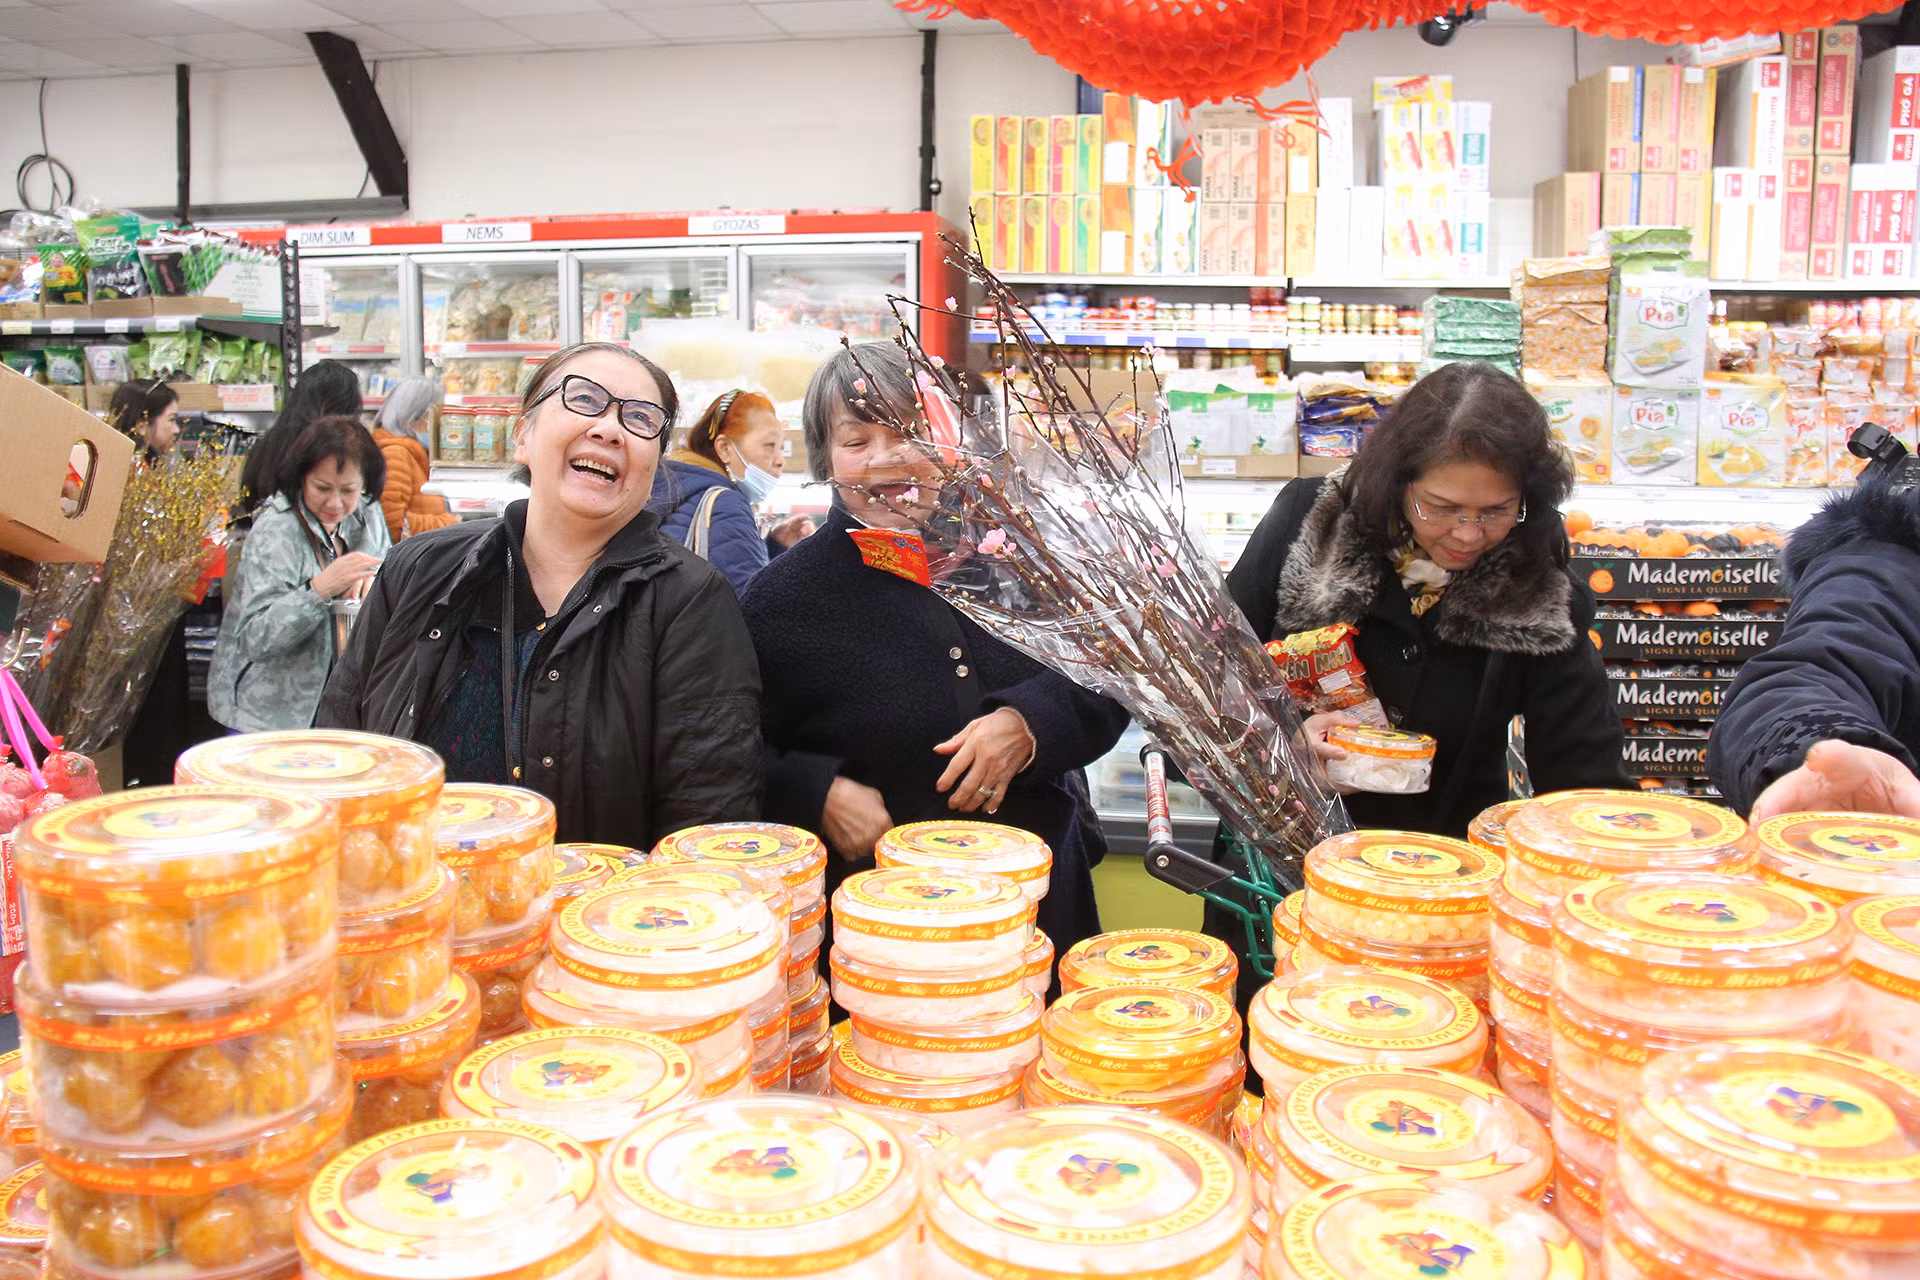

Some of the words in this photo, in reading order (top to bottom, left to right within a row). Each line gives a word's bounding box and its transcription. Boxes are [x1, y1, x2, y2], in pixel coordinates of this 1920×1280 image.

[713, 219, 760, 231] GYOZAS
[300, 231, 323, 245] DIM
[327, 230, 355, 244] SUM
[466, 226, 504, 240] NEMS
[1635, 407, 1665, 423] Pia
[1728, 413, 1756, 427] Pia
[1628, 562, 1781, 585] Mademoiselle
[1706, 586, 1749, 594] QUALITÉ
[1616, 623, 1769, 646] Mademoiselle
[1694, 648, 1737, 656] QUALITÉ
[1641, 669, 1699, 678] Mademoiselle
[1325, 886, 1357, 901] Chúc
[1359, 897, 1408, 912] Mừng
[1414, 901, 1459, 912] Năm
[914, 929, 950, 940] Mới
[1725, 974, 1790, 988] Mừng
[468, 1040, 517, 1068] BONNE
[524, 1031, 544, 1042] ET
[549, 1027, 632, 1041] JOYEUSE
[912, 1039, 963, 1052] Mừng
[1327, 1064, 1390, 1080] ANNEE
[1294, 1077, 1325, 1116] JOYEUSE
[1310, 1132, 1381, 1167] BONNE
